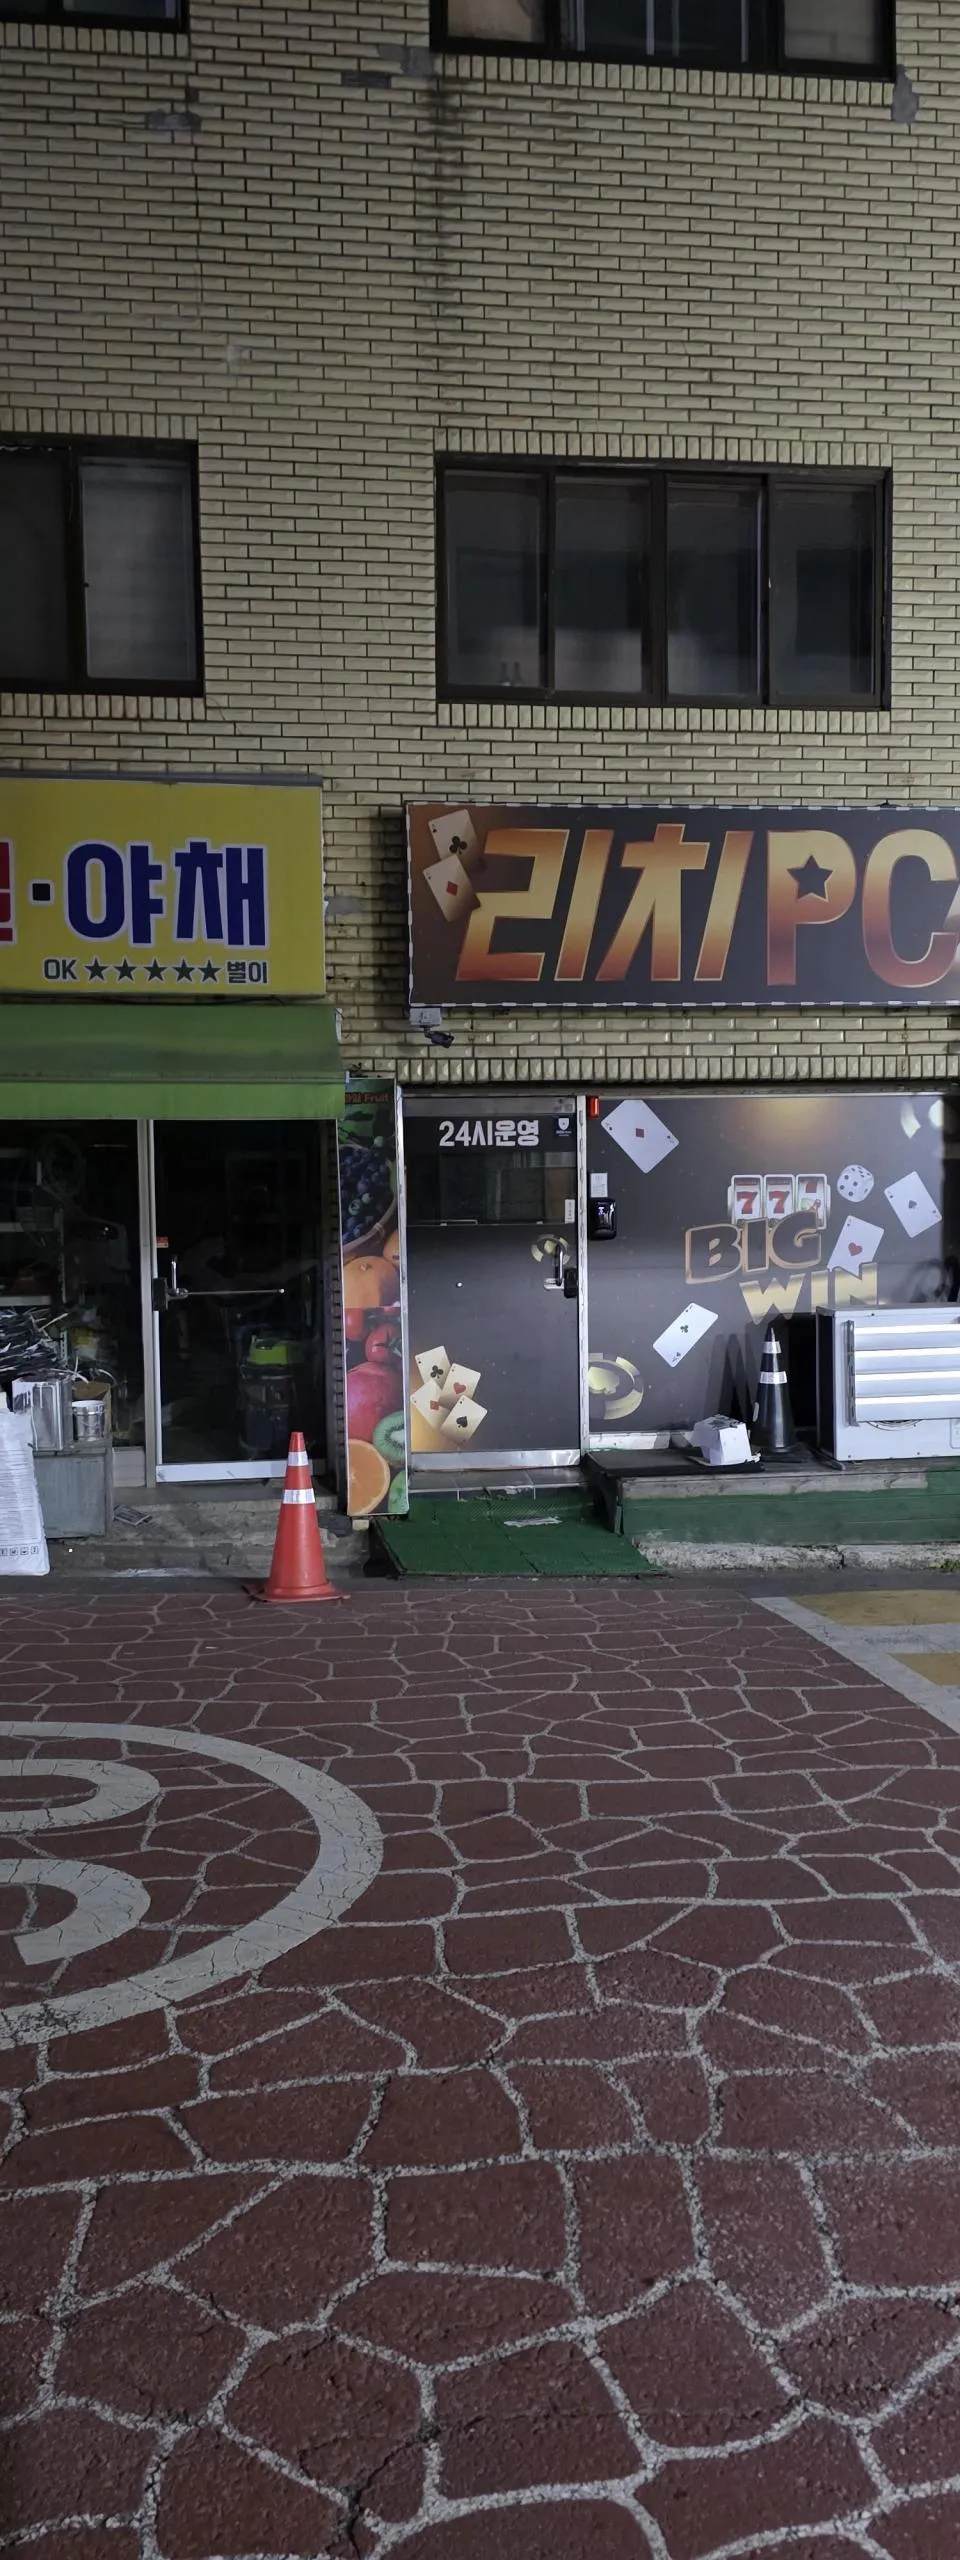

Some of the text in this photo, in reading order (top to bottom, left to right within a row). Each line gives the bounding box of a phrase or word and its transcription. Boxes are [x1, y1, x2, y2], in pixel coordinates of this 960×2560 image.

[227, 959, 268, 984] 별이
[438, 1119, 540, 1147] 24시운영
[685, 1210, 822, 1285] BIG
[739, 1261, 879, 1326] WIN
